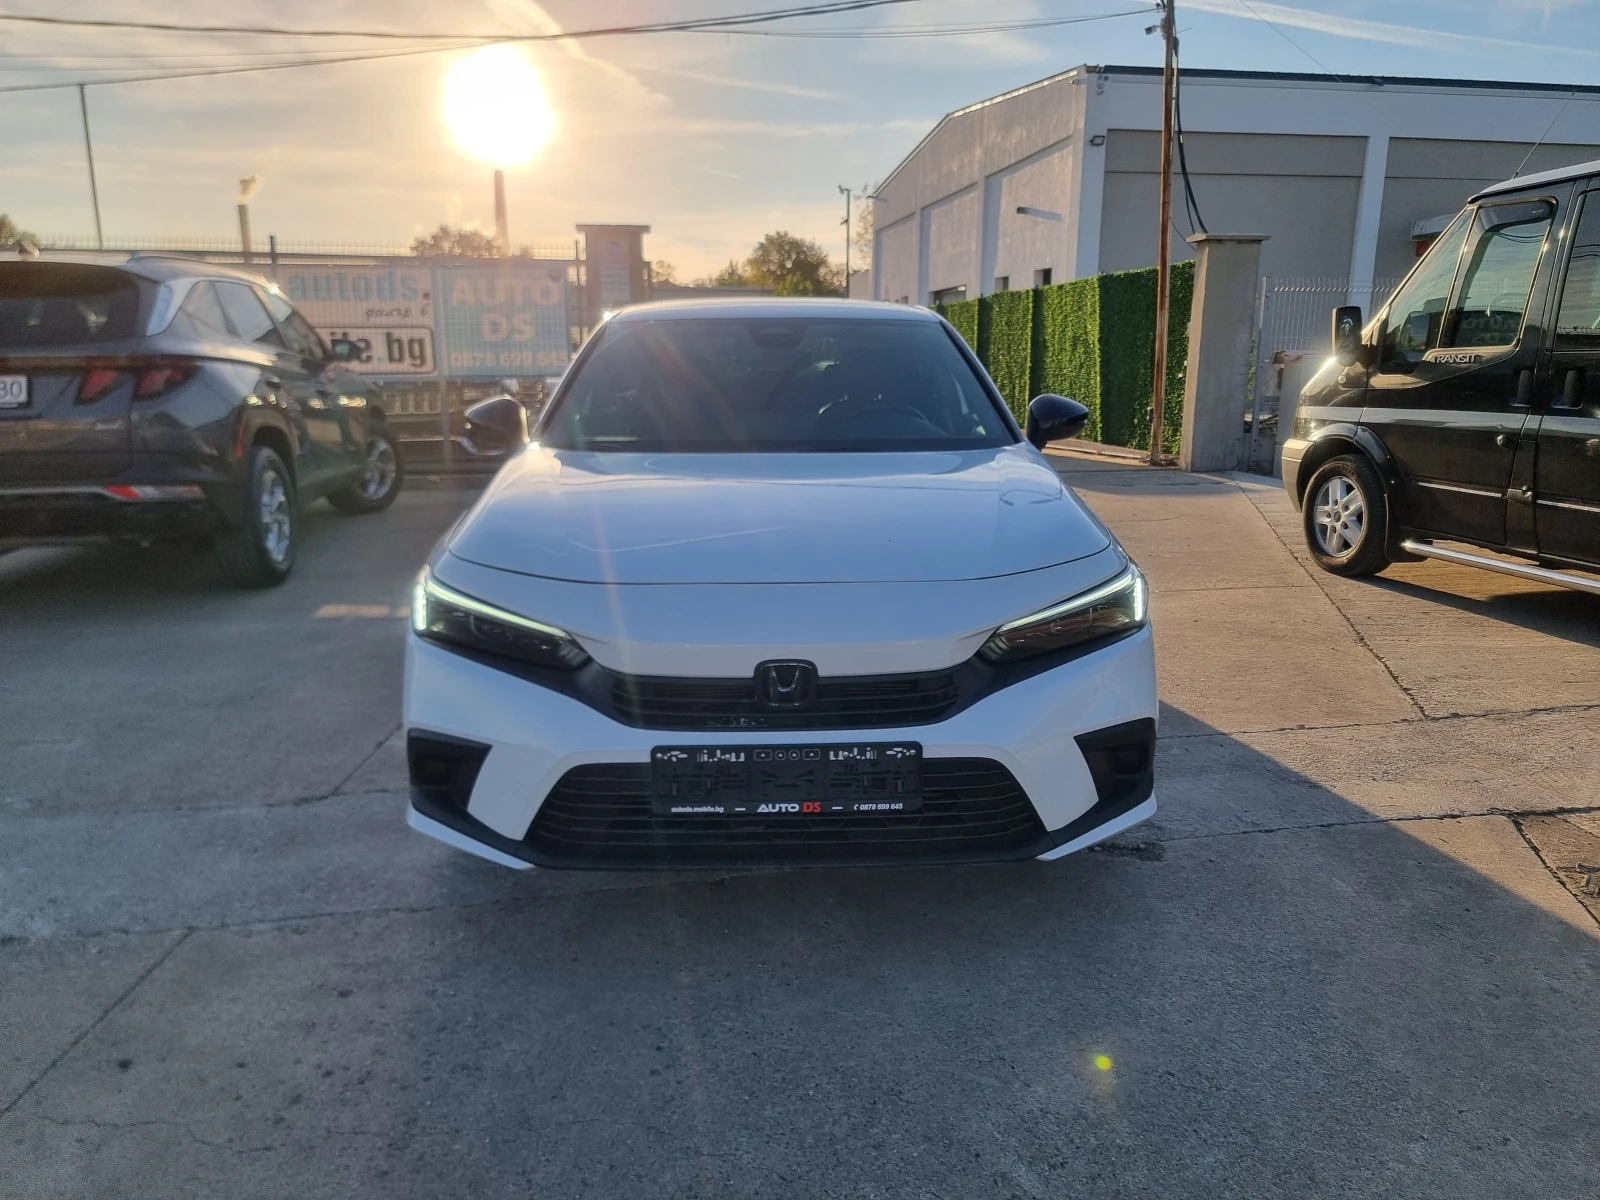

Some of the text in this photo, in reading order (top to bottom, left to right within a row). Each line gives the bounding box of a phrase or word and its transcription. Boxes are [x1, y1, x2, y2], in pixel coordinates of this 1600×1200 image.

[451, 277, 561, 307] AUTO
[482, 311, 537, 343] DS
[757, 803, 800, 813] AUTO
[802, 801, 822, 813] DS
[860, 803, 877, 811] 0878
